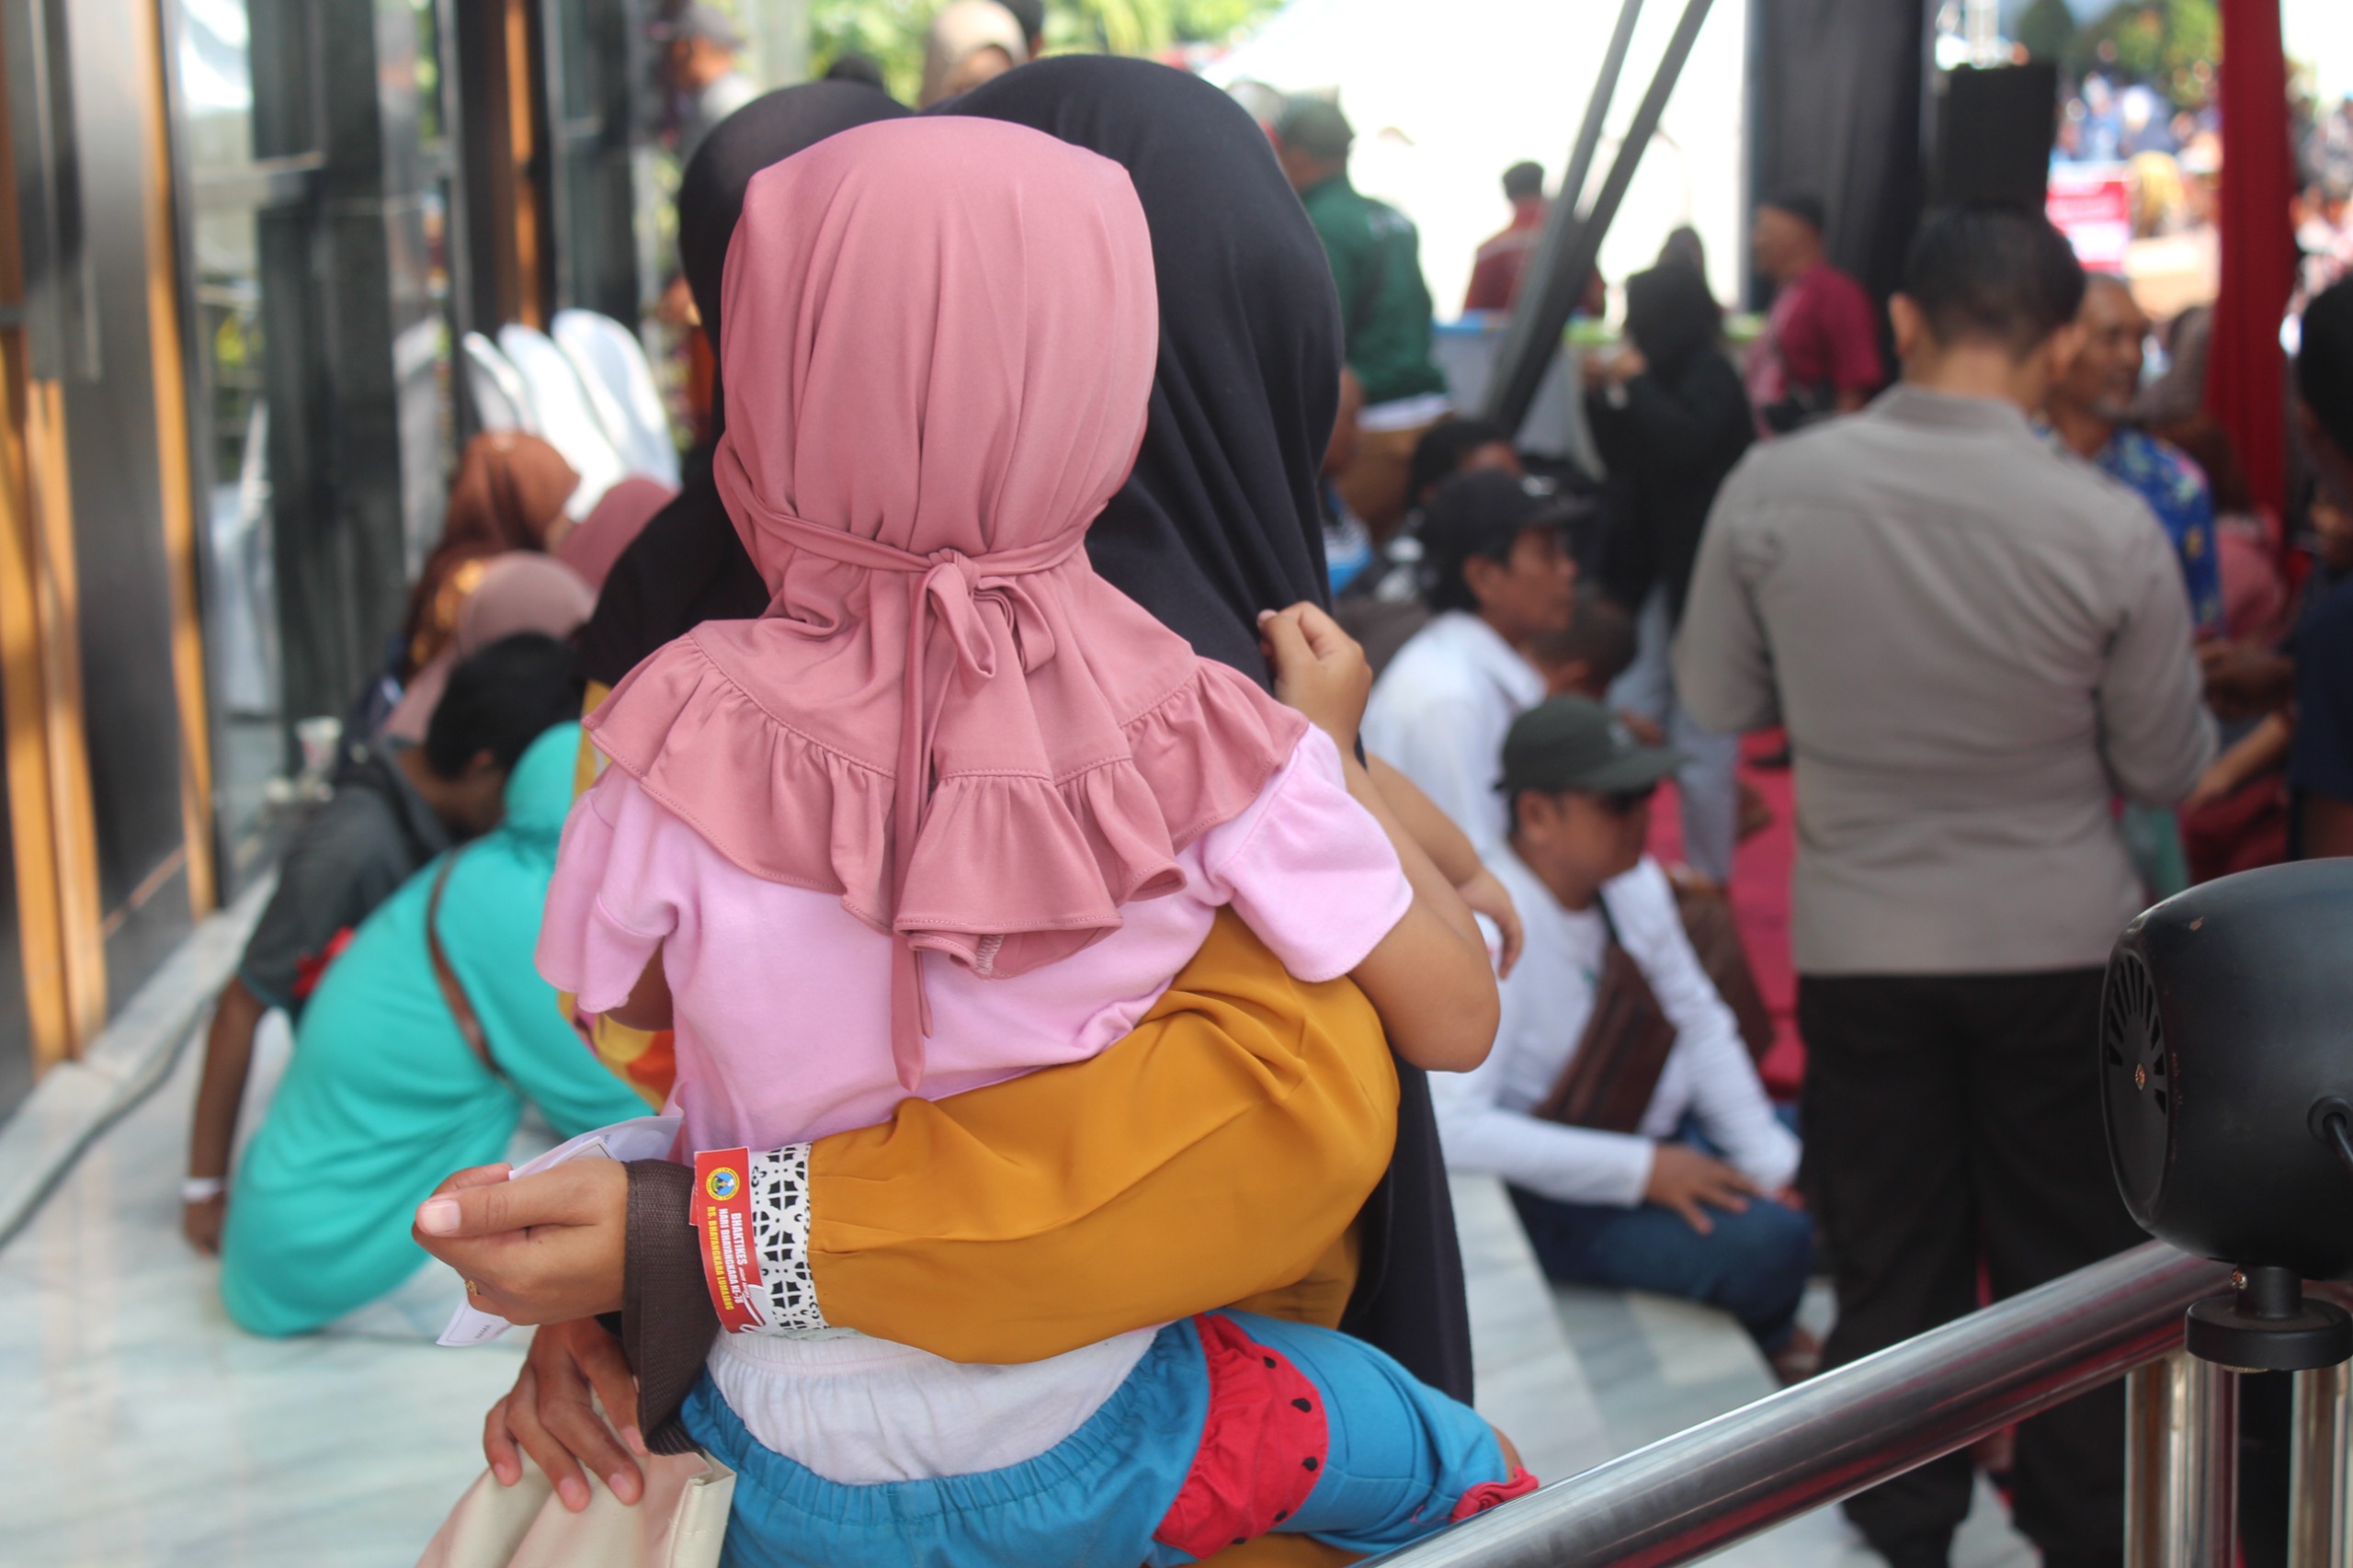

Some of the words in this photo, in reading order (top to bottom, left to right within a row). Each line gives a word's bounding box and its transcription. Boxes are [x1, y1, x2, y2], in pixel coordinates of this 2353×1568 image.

[707, 1206, 717, 1219] RS.
[719, 1208, 729, 1228] HARI
[708, 1221, 725, 1276] BHAYANGKARA
[721, 1229, 737, 1284] BHAYANGKARA
[731, 1212, 748, 1265] BHAKTIKES
[717, 1276, 734, 1310] LUMAJANG
